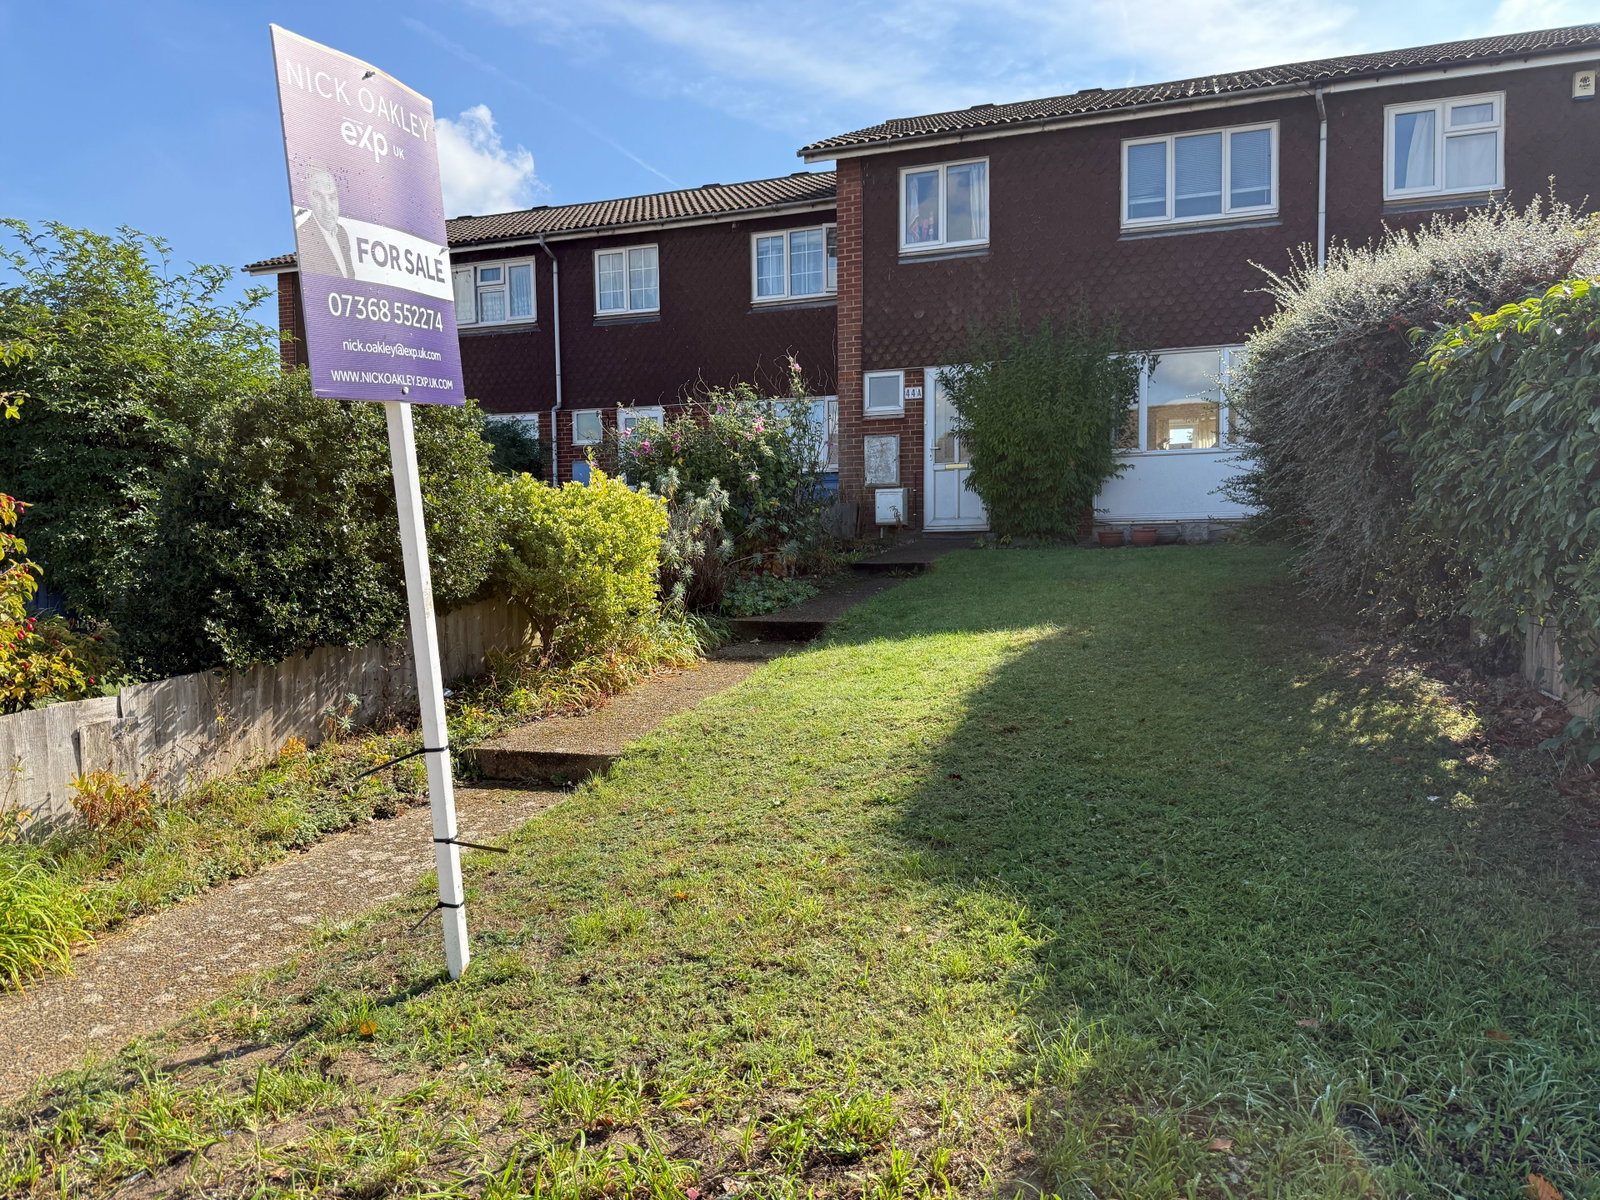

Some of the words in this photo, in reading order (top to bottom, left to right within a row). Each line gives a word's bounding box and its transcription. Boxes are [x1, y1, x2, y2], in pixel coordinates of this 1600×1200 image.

[285, 59, 351, 106] NICK
[357, 86, 429, 142] OAKLEY
[341, 119, 388, 163] exp
[393, 145, 405, 160] UK
[356, 237, 402, 271] FOR
[404, 248, 446, 284] SALE
[328, 292, 391, 322] 07368
[394, 302, 443, 332] 552274
[905, 388, 922, 398] 44A
